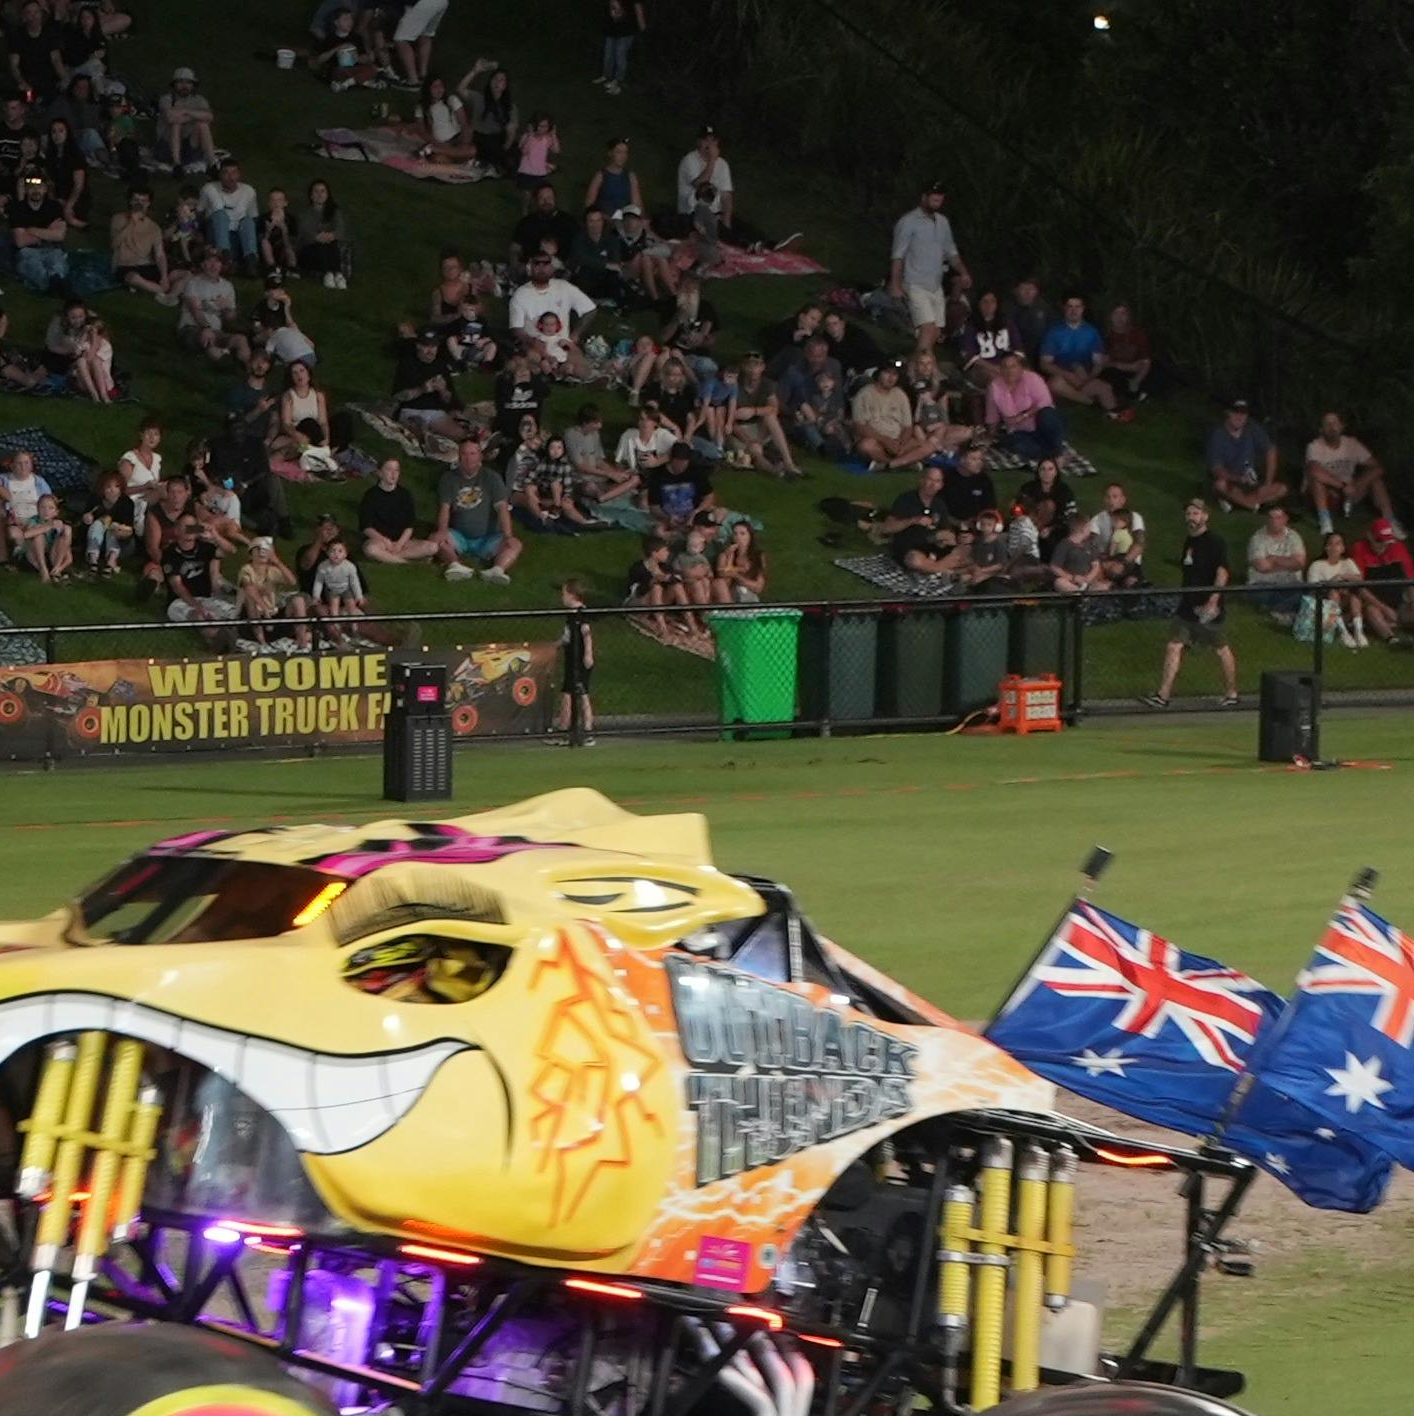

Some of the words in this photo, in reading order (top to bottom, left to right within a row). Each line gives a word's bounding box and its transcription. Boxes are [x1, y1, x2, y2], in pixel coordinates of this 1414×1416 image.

[148, 653, 387, 698] WELCOME
[100, 699, 250, 745] MONSTER
[256, 693, 360, 737] TRUCK
